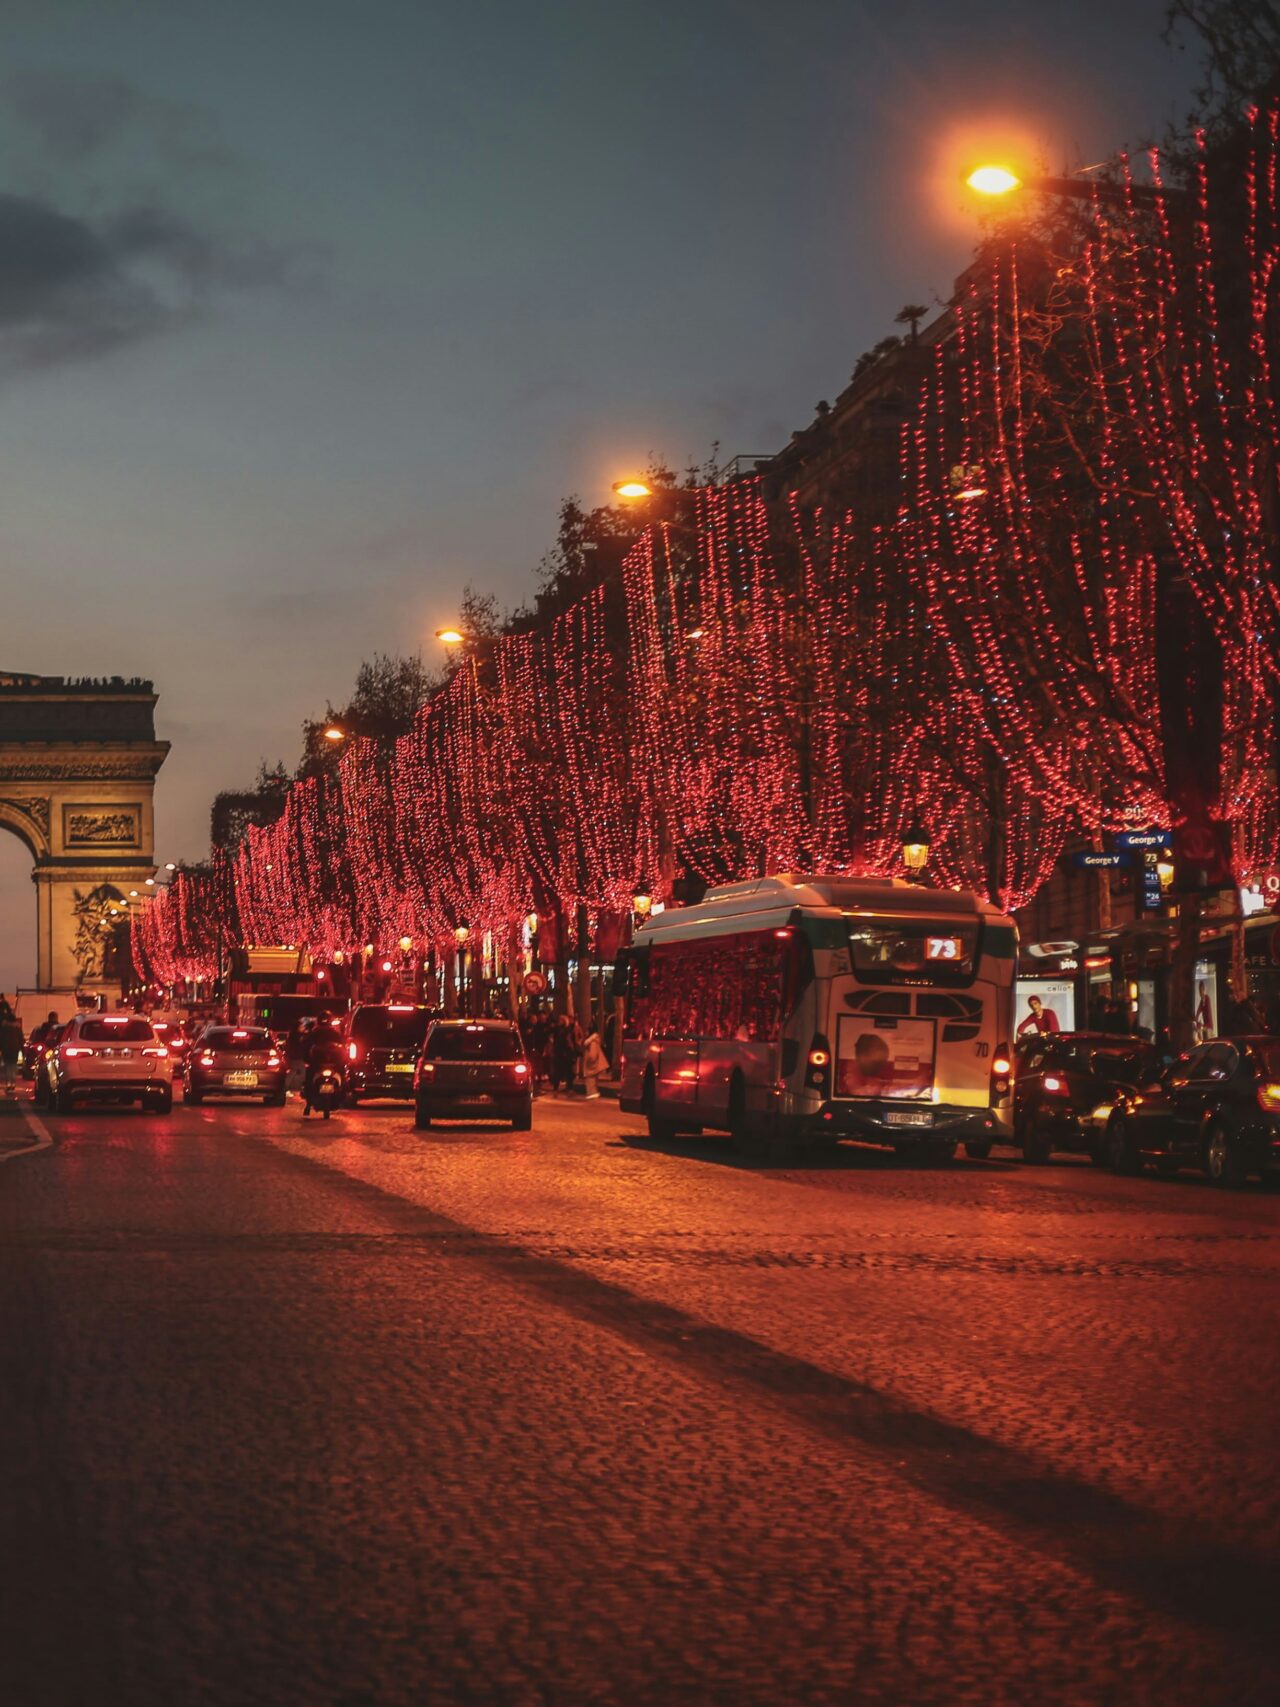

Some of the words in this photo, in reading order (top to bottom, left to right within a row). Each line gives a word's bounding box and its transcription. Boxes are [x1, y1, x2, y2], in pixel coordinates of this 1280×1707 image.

[1128, 836, 1156, 845] George
[1157, 835, 1164, 843] V
[1085, 856, 1112, 865] George
[1113, 856, 1120, 864] V
[1145, 853, 1157, 862] 73
[930, 938, 956, 958] 73
[975, 1042, 989, 1058] 70
